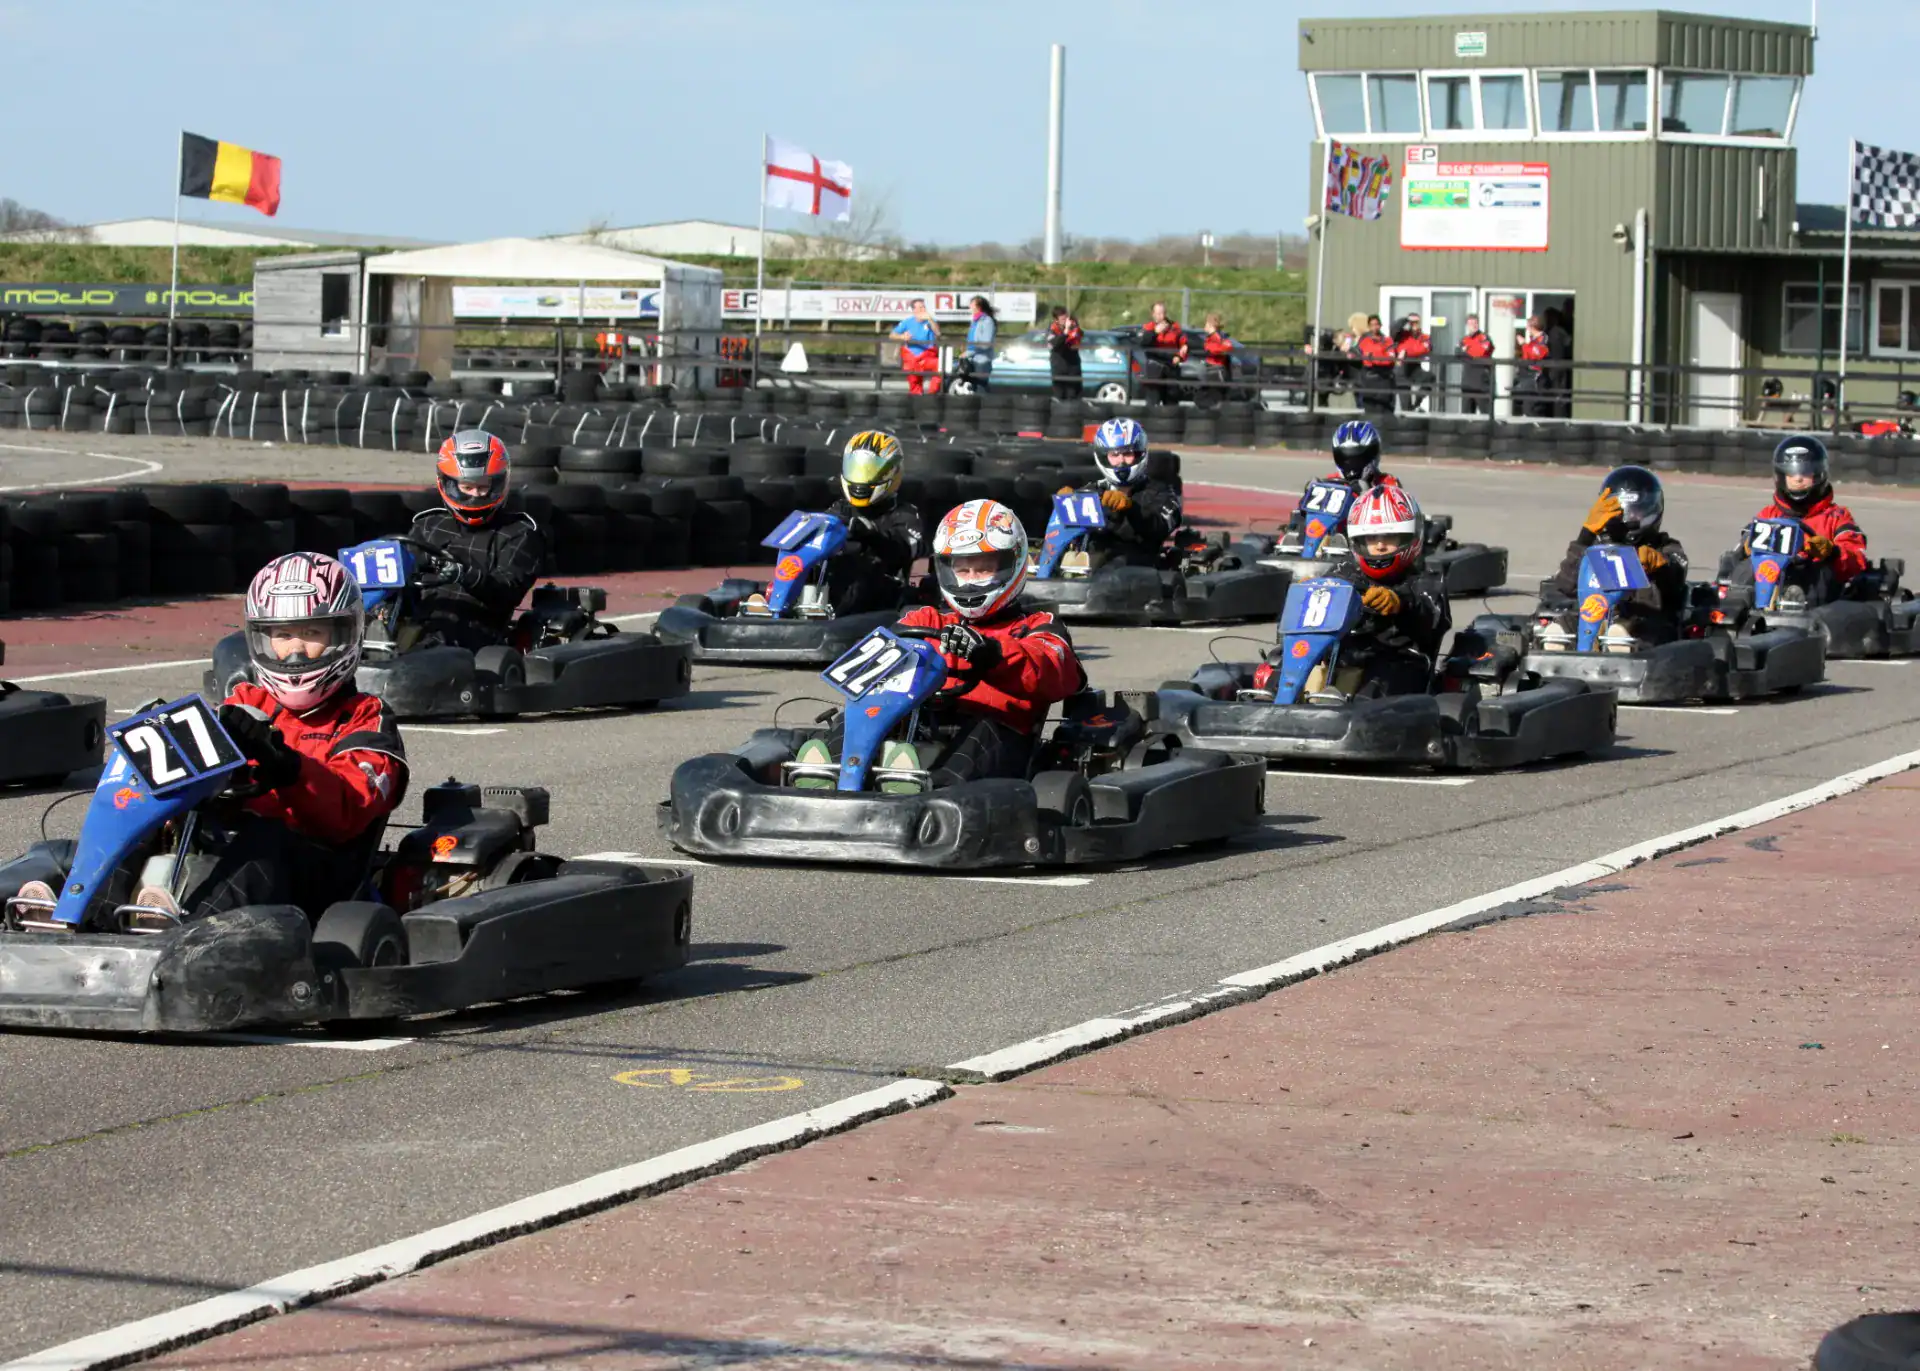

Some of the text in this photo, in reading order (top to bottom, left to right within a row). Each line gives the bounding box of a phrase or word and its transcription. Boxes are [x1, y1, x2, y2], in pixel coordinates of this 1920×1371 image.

[1407, 147, 1437, 161] EP
[1062, 496, 1099, 524] 14
[1306, 486, 1346, 514] 28
[1751, 522, 1793, 555] 21
[351, 547, 398, 585] 15
[1606, 555, 1628, 588] 7
[271, 583, 314, 592] KBC
[1302, 589, 1332, 628] 8
[829, 637, 902, 694] 22
[124, 705, 221, 785] 27
